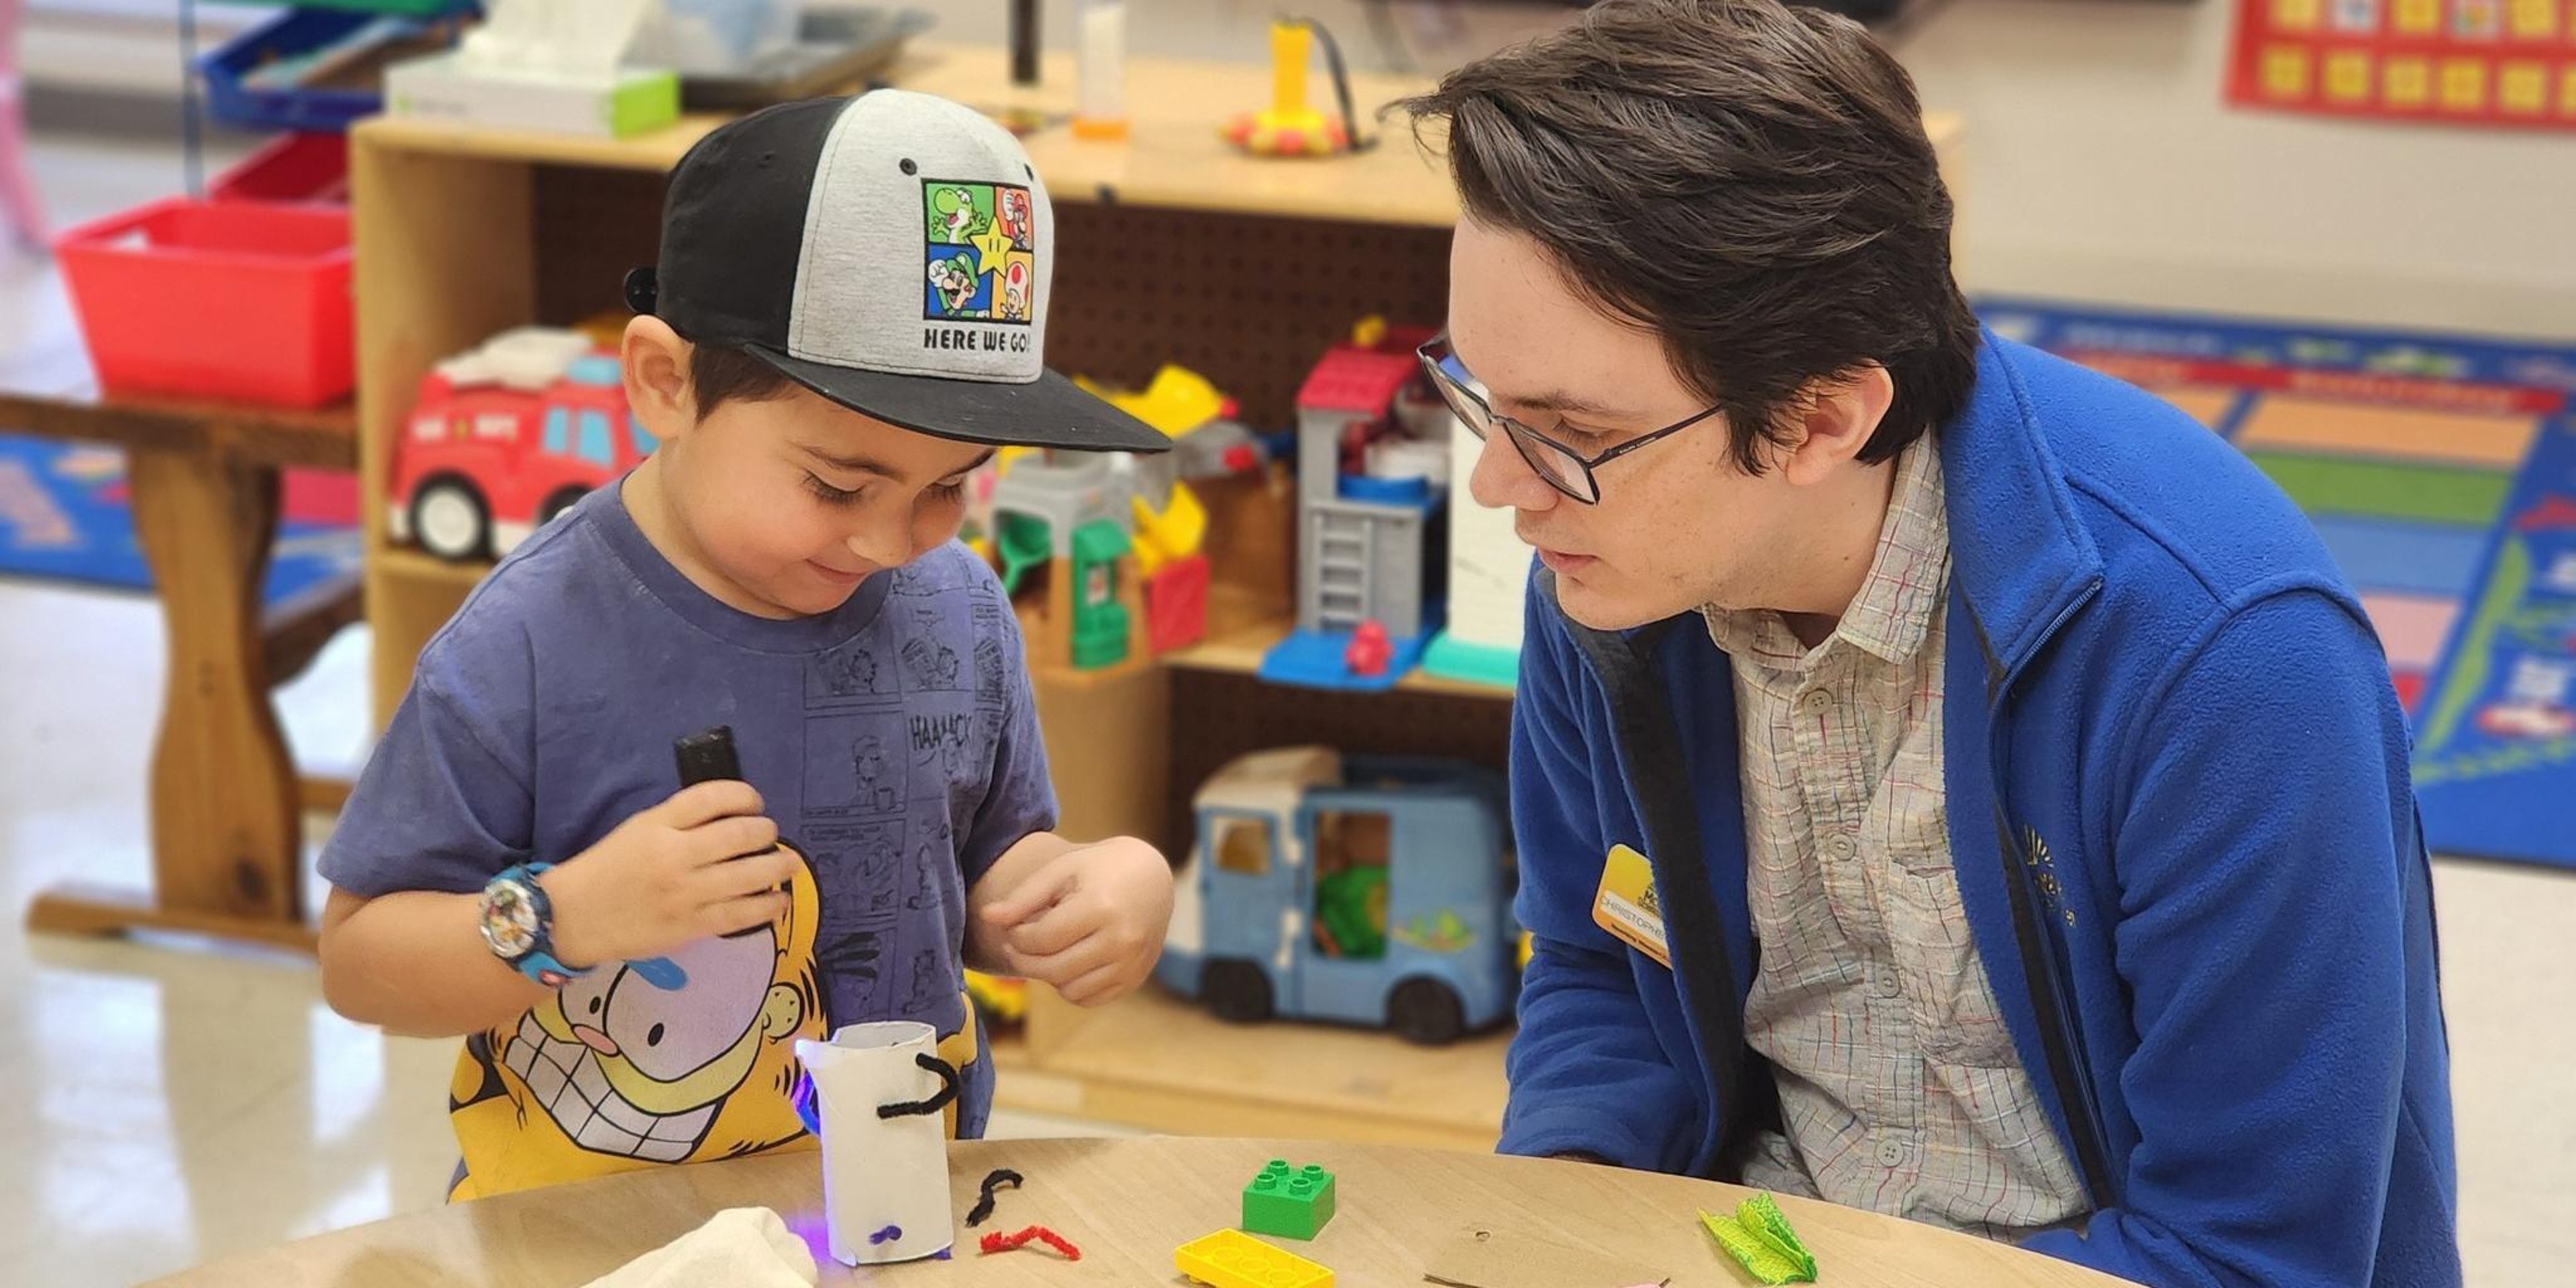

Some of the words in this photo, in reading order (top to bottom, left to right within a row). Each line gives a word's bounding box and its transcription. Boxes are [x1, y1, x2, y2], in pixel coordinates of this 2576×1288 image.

[924, 328, 976, 350] HERE
[983, 331, 1006, 351] WE
[1010, 332, 1030, 353] GO!
